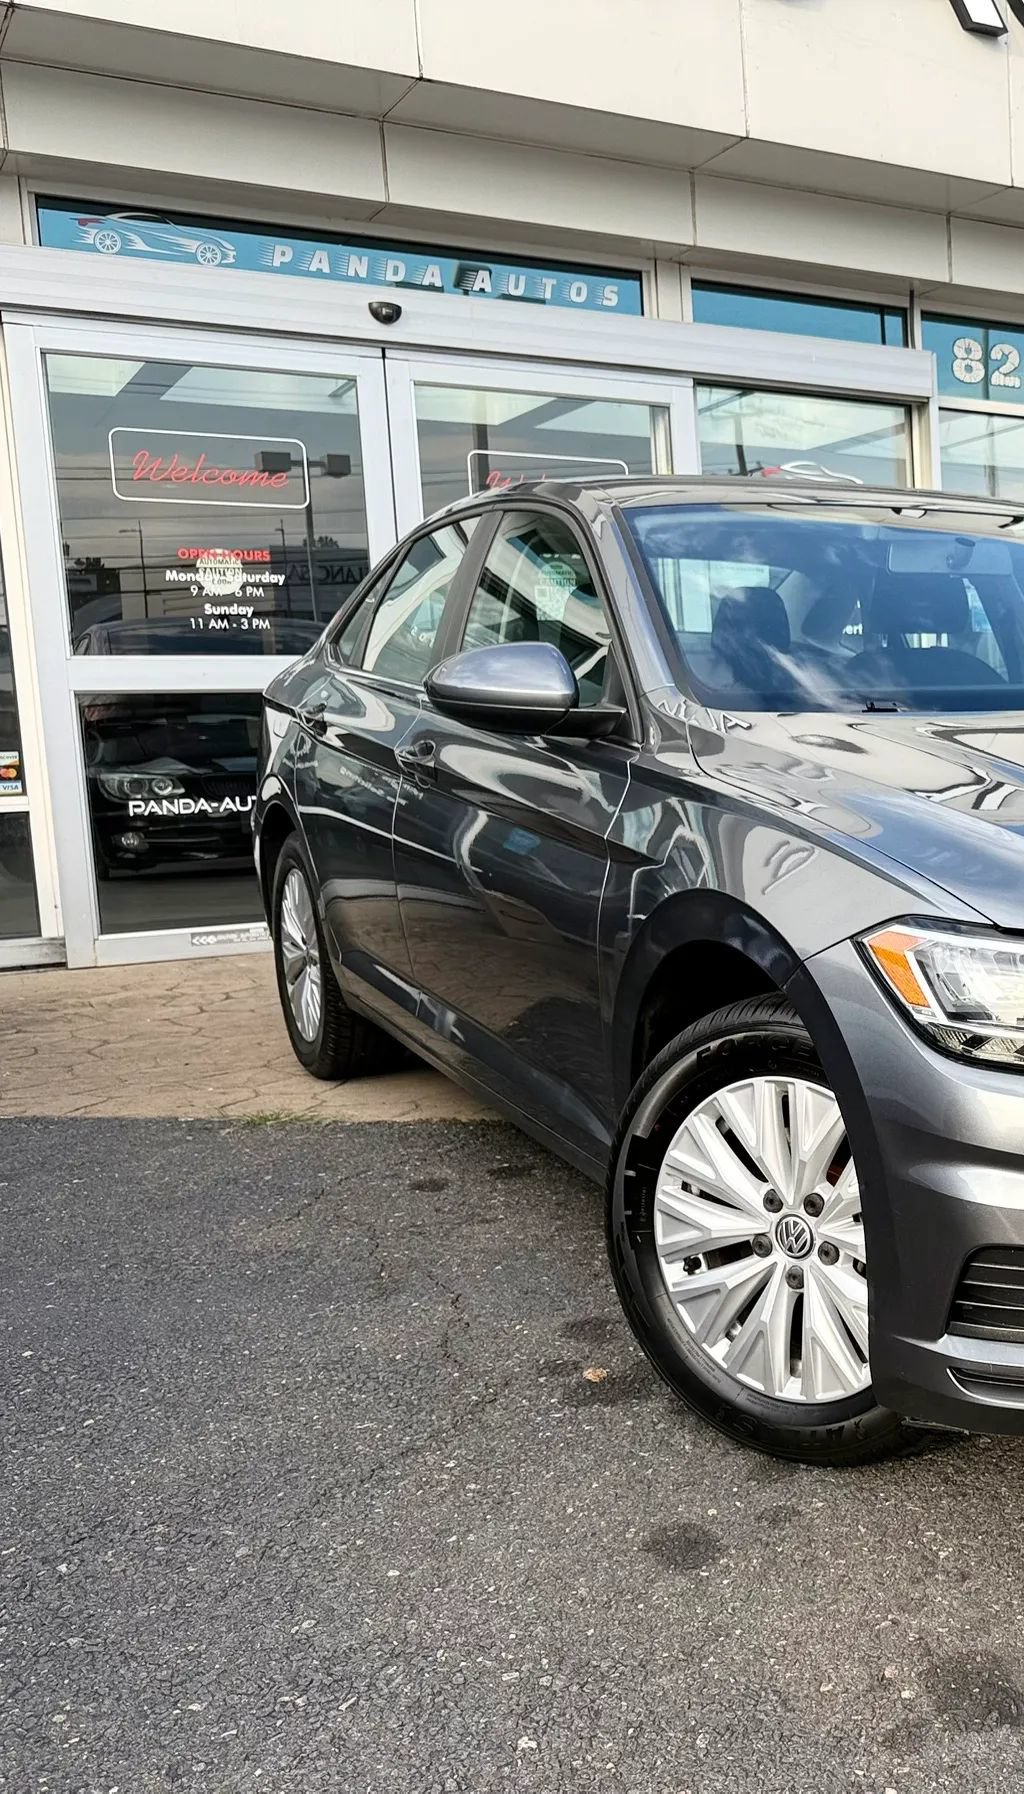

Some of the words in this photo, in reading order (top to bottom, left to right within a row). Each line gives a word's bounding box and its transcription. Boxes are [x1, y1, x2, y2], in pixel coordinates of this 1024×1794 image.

[273, 244, 443, 287] PANDA
[471, 270, 620, 307] AUTOS
[132, 449, 289, 489] Welcome
[190, 585, 198, 597] 9
[246, 586, 264, 597] PM
[204, 603, 254, 617] Sunday
[190, 618, 204, 630] 11
[208, 618, 229, 630] AM
[240, 618, 248, 630] 3
[252, 618, 271, 630] PM
[128, 795, 257, 817] PANDA-AU
